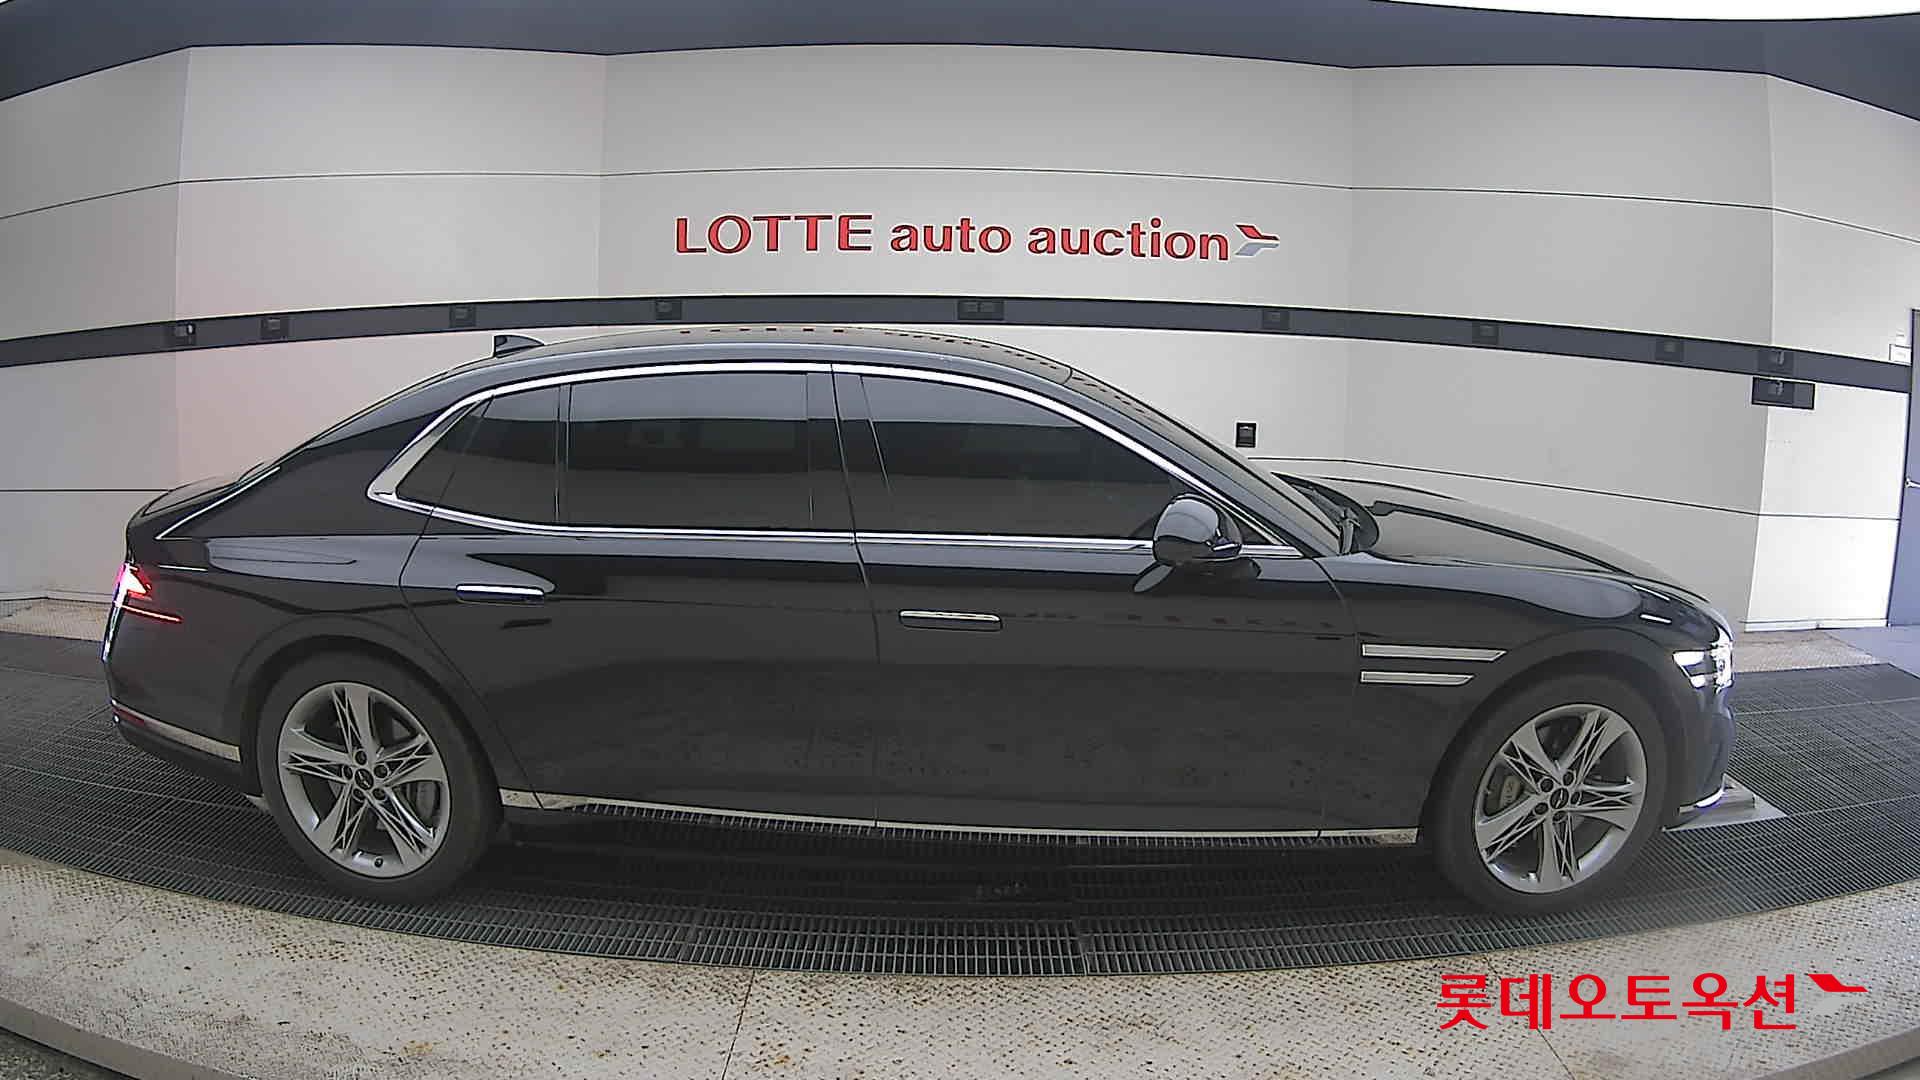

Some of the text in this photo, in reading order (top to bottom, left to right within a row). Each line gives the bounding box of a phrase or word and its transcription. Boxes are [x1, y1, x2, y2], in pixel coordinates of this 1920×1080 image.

[676, 214, 1231, 261] LOTTE auto auction
